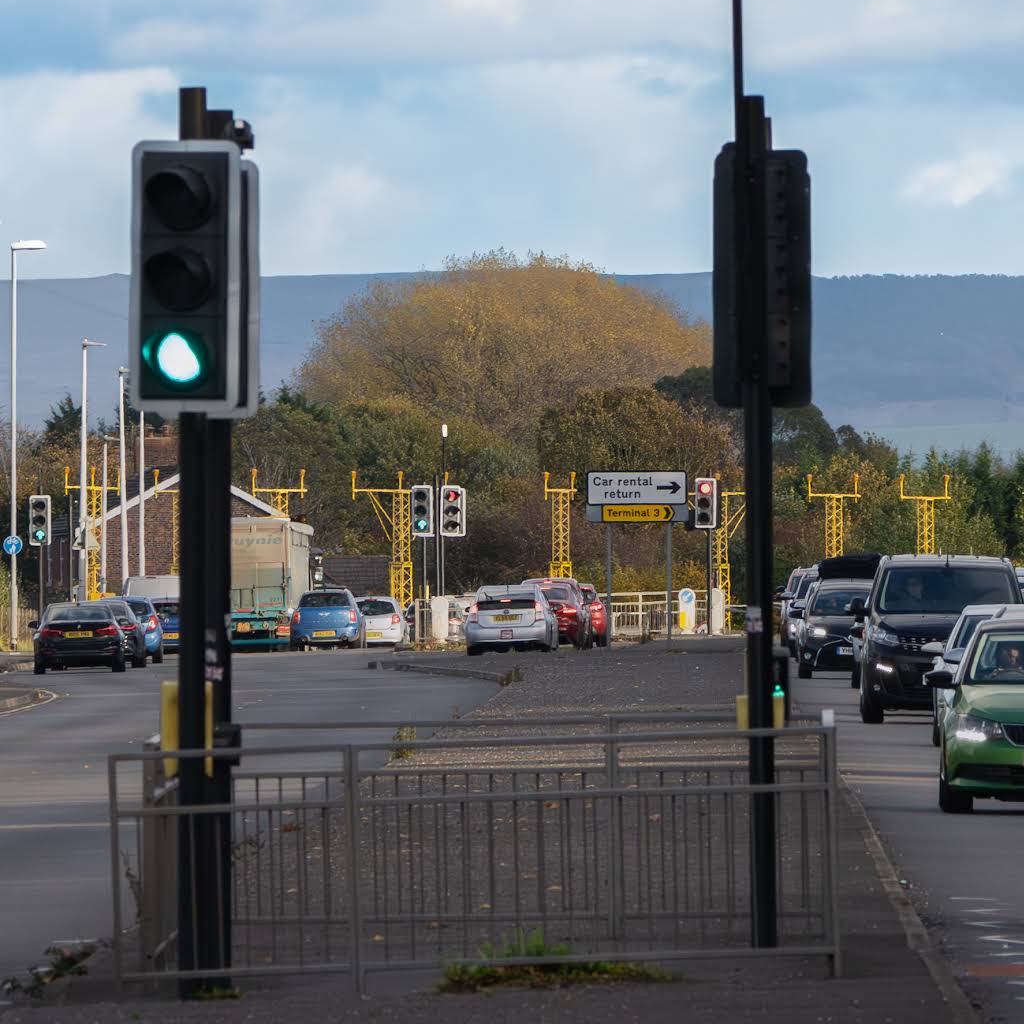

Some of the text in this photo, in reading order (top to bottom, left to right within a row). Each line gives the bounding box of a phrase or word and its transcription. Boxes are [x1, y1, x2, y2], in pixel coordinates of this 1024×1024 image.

[593, 476, 653, 487] Car rental
[604, 489, 641, 498] return
[608, 508, 660, 517] Terminal 3
